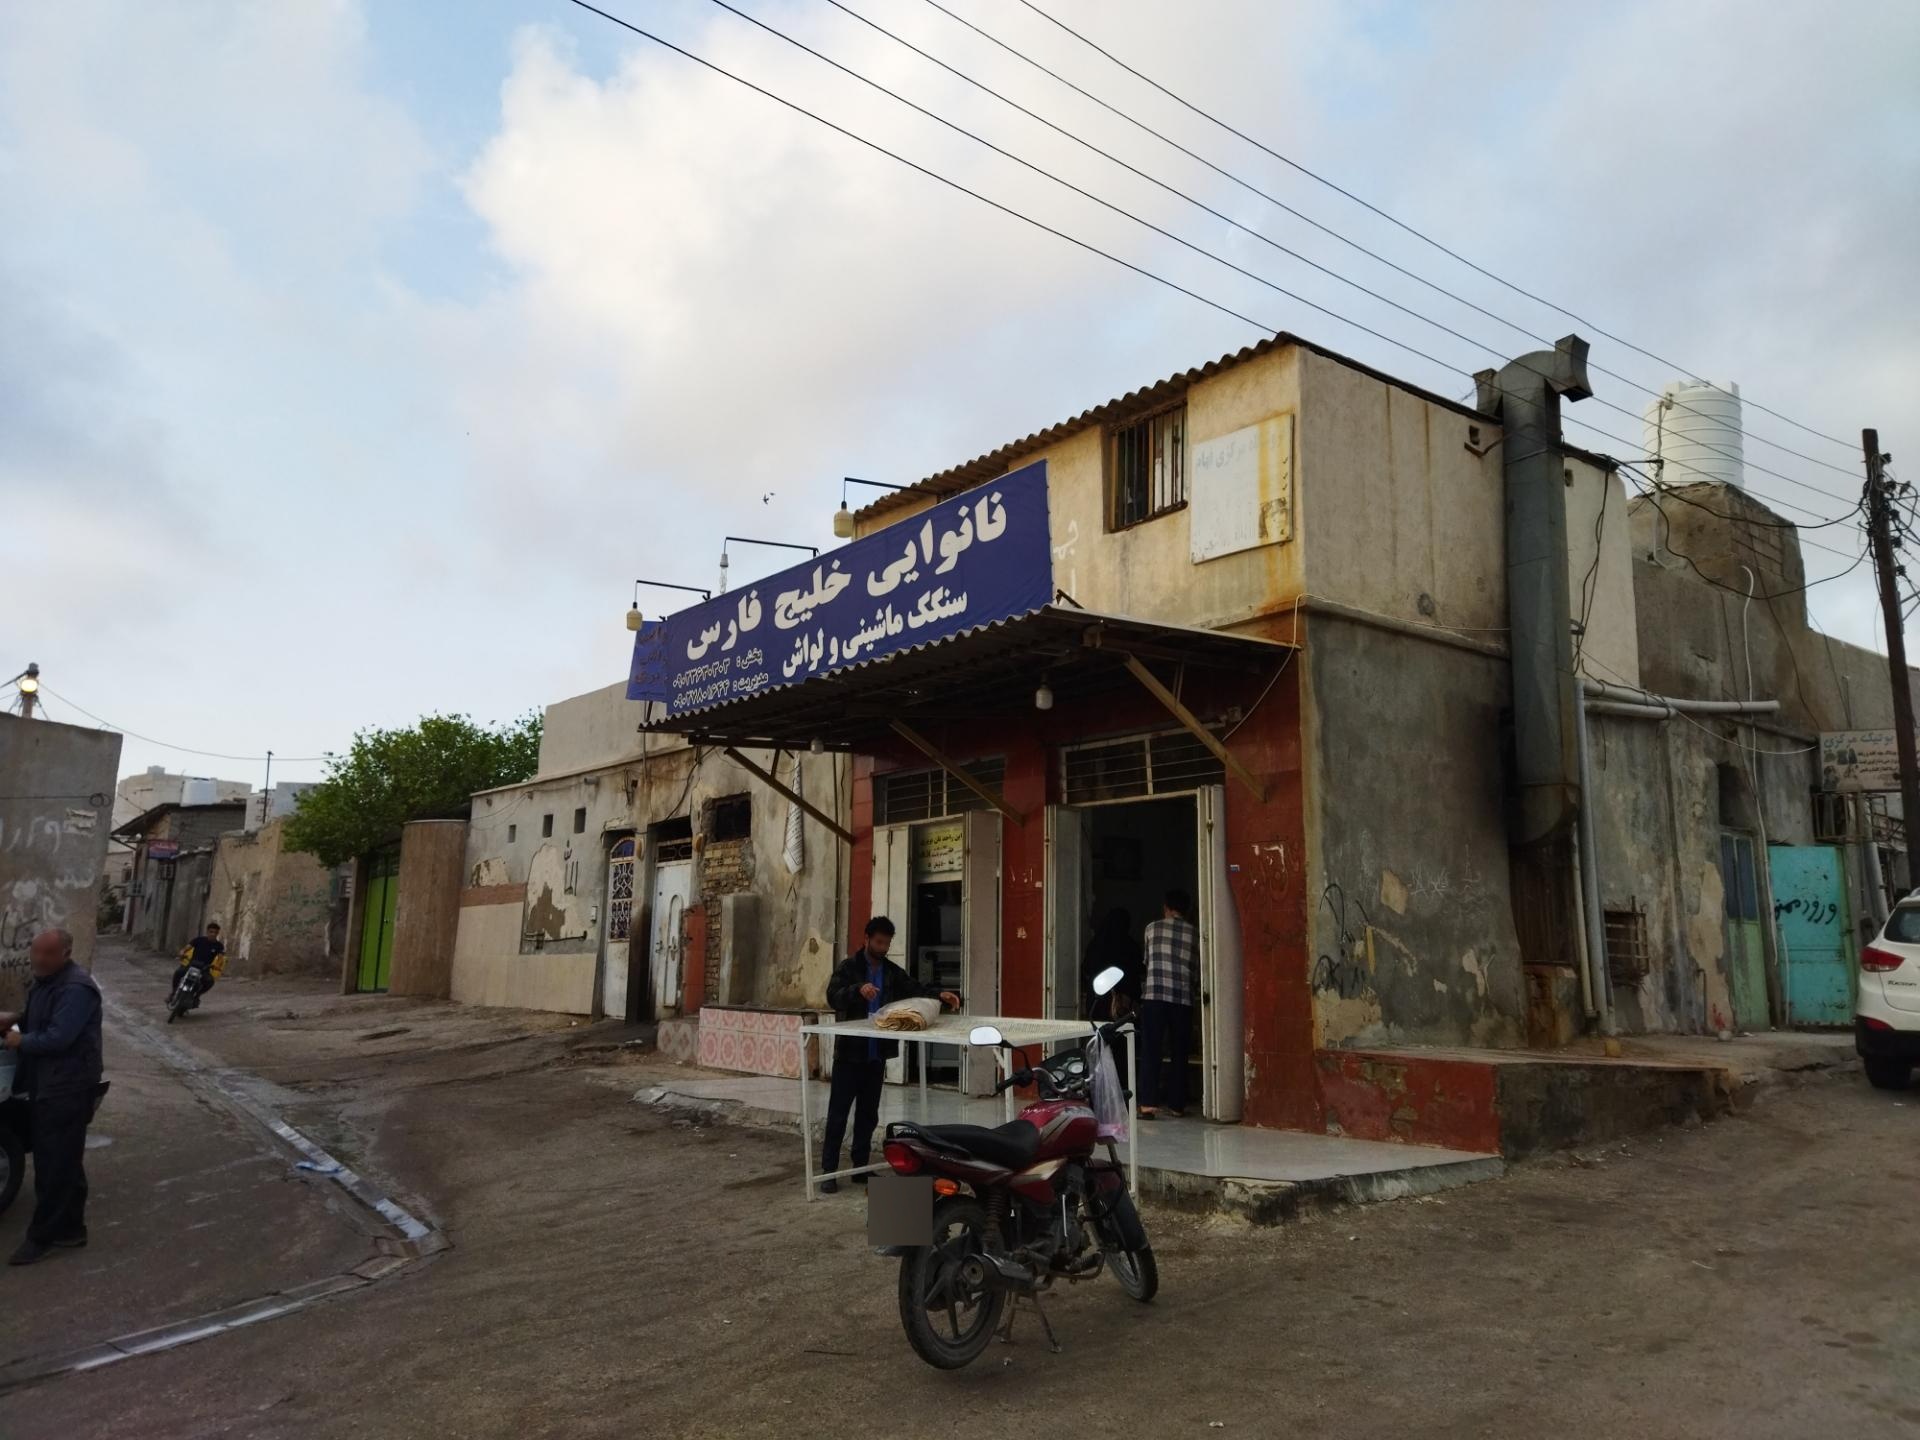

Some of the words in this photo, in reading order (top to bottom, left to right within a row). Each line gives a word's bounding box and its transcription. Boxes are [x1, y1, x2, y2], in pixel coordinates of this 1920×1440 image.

[867, 491, 1007, 598] نانوایی
[687, 590, 763, 662] فارس
[774, 558, 852, 631] خلیج
[782, 626, 825, 679] لواش
[829, 637, 839, 666] و
[843, 604, 904, 660] ماشینی
